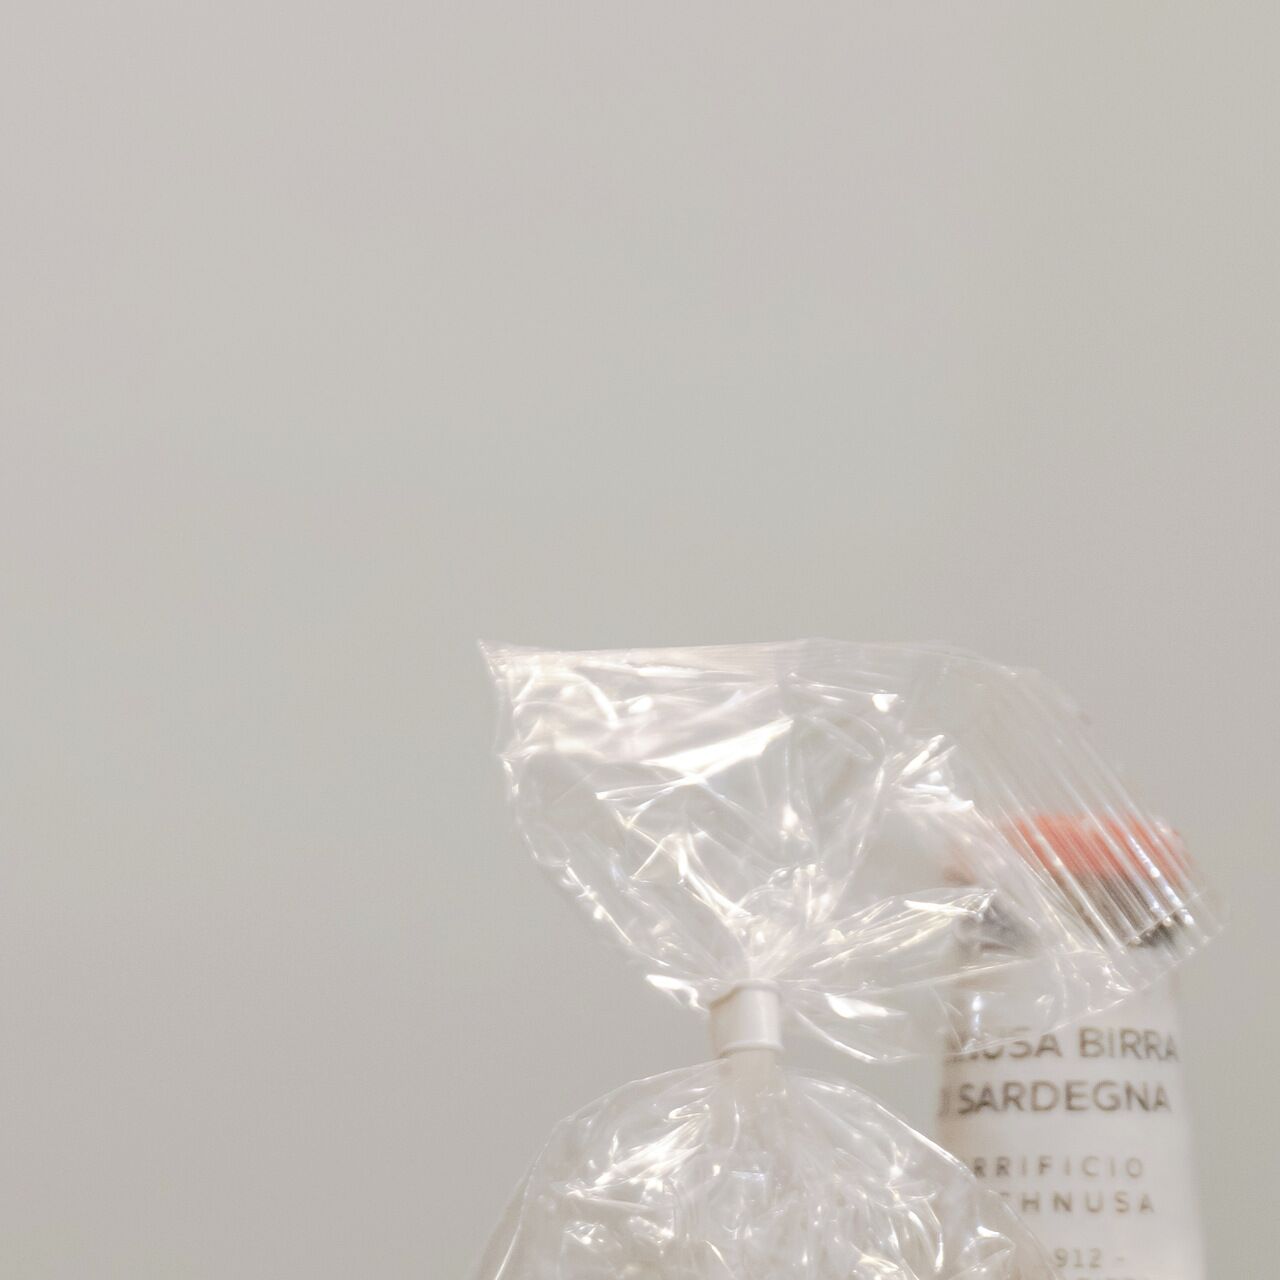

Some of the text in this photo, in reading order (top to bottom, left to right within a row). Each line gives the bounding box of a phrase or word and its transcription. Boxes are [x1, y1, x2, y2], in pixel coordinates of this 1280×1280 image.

[1078, 1026, 1179, 1063] BIRRA
[957, 1080, 1173, 1115] SARDEGNA
[1000, 1190, 1156, 1215] HNUSA
